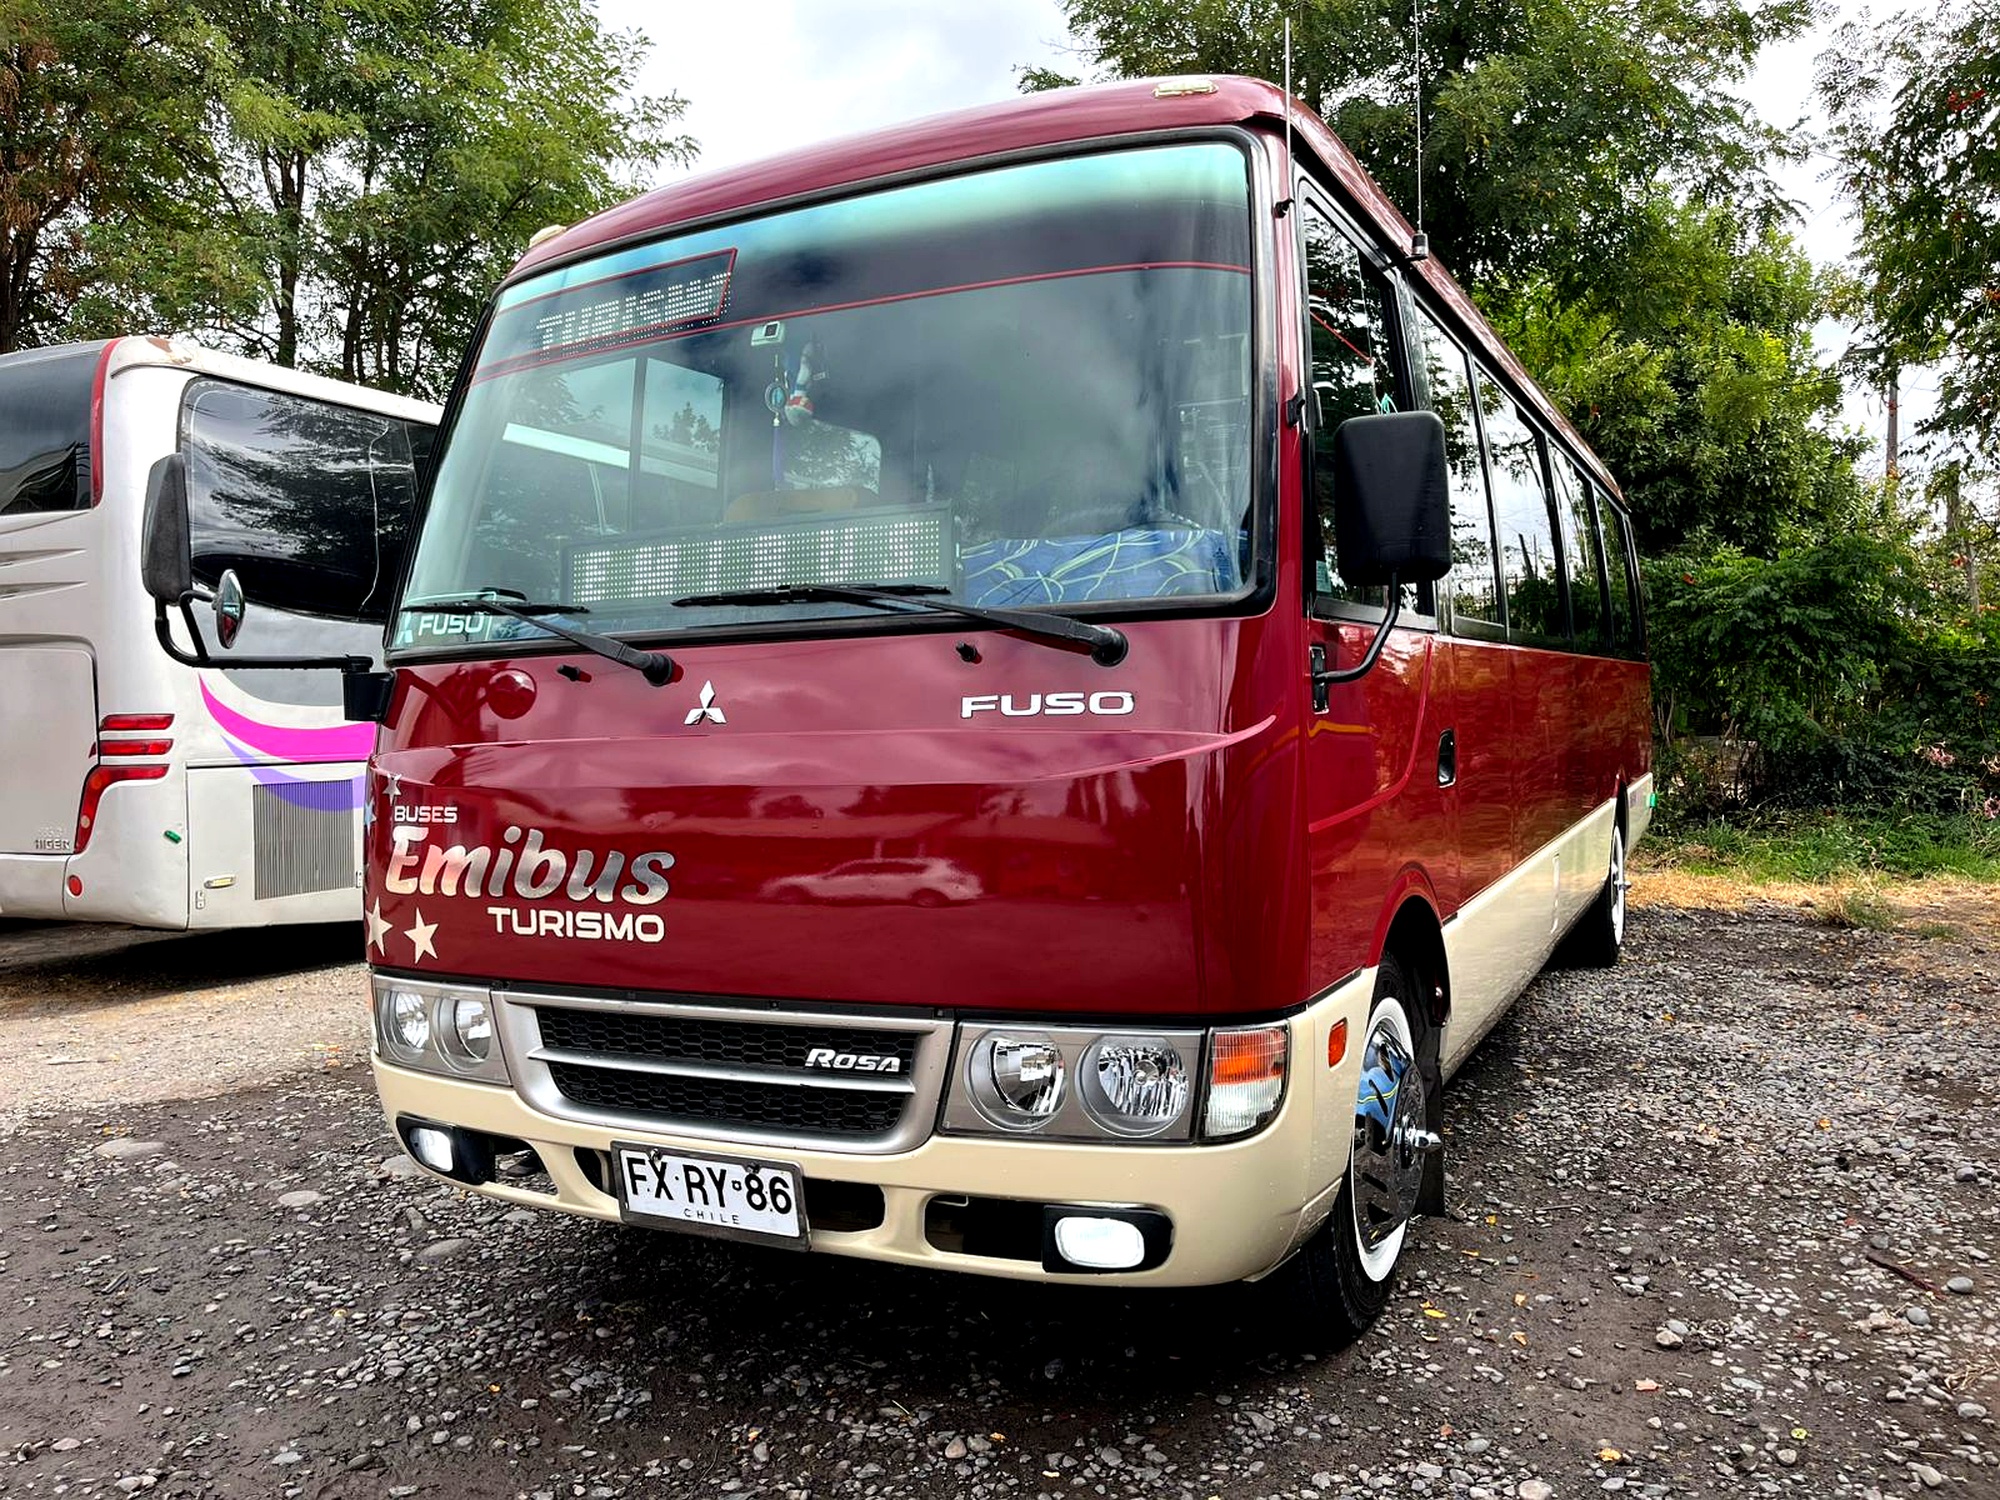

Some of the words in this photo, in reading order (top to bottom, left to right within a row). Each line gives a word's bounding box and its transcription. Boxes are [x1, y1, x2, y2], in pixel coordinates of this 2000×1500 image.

[418, 613, 485, 637] FUSO
[961, 691, 1135, 719] FUSO
[394, 805, 458, 824] BUSES
[385, 825, 676, 906] Emibus
[487, 906, 666, 943] TURISMO
[683, 1208, 741, 1225] CHILE
